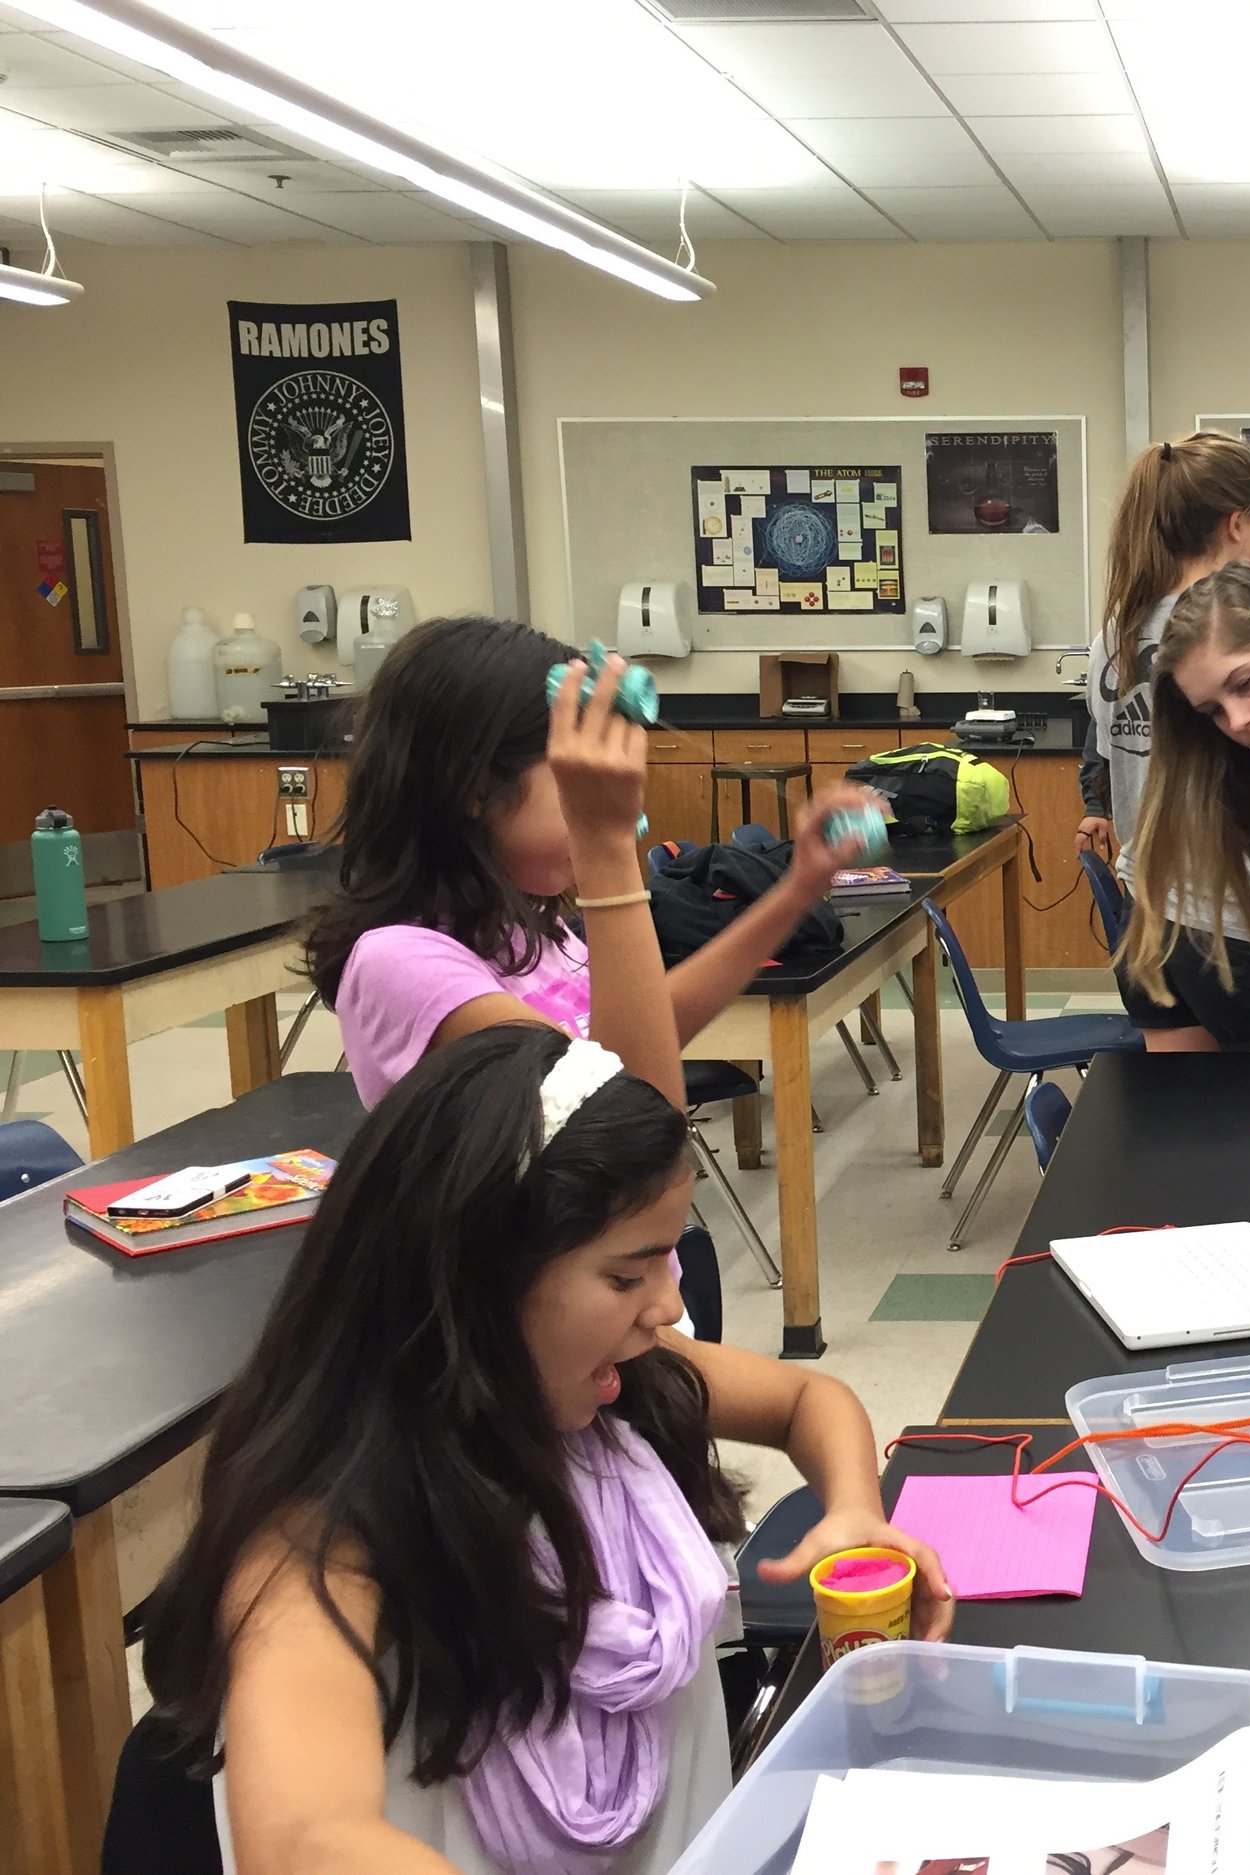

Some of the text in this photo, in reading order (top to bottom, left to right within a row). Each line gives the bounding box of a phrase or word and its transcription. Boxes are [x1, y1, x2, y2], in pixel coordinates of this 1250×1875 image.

[238, 318, 390, 358] RAMONES
[273, 374, 363, 407] JOHNNY
[252, 408, 285, 498] TOMMY
[362, 408, 389, 463] JOEY
[930, 435, 1051, 446] SERENDIPITY
[814, 469, 833, 477] THE
[835, 469, 861, 477] ATOM
